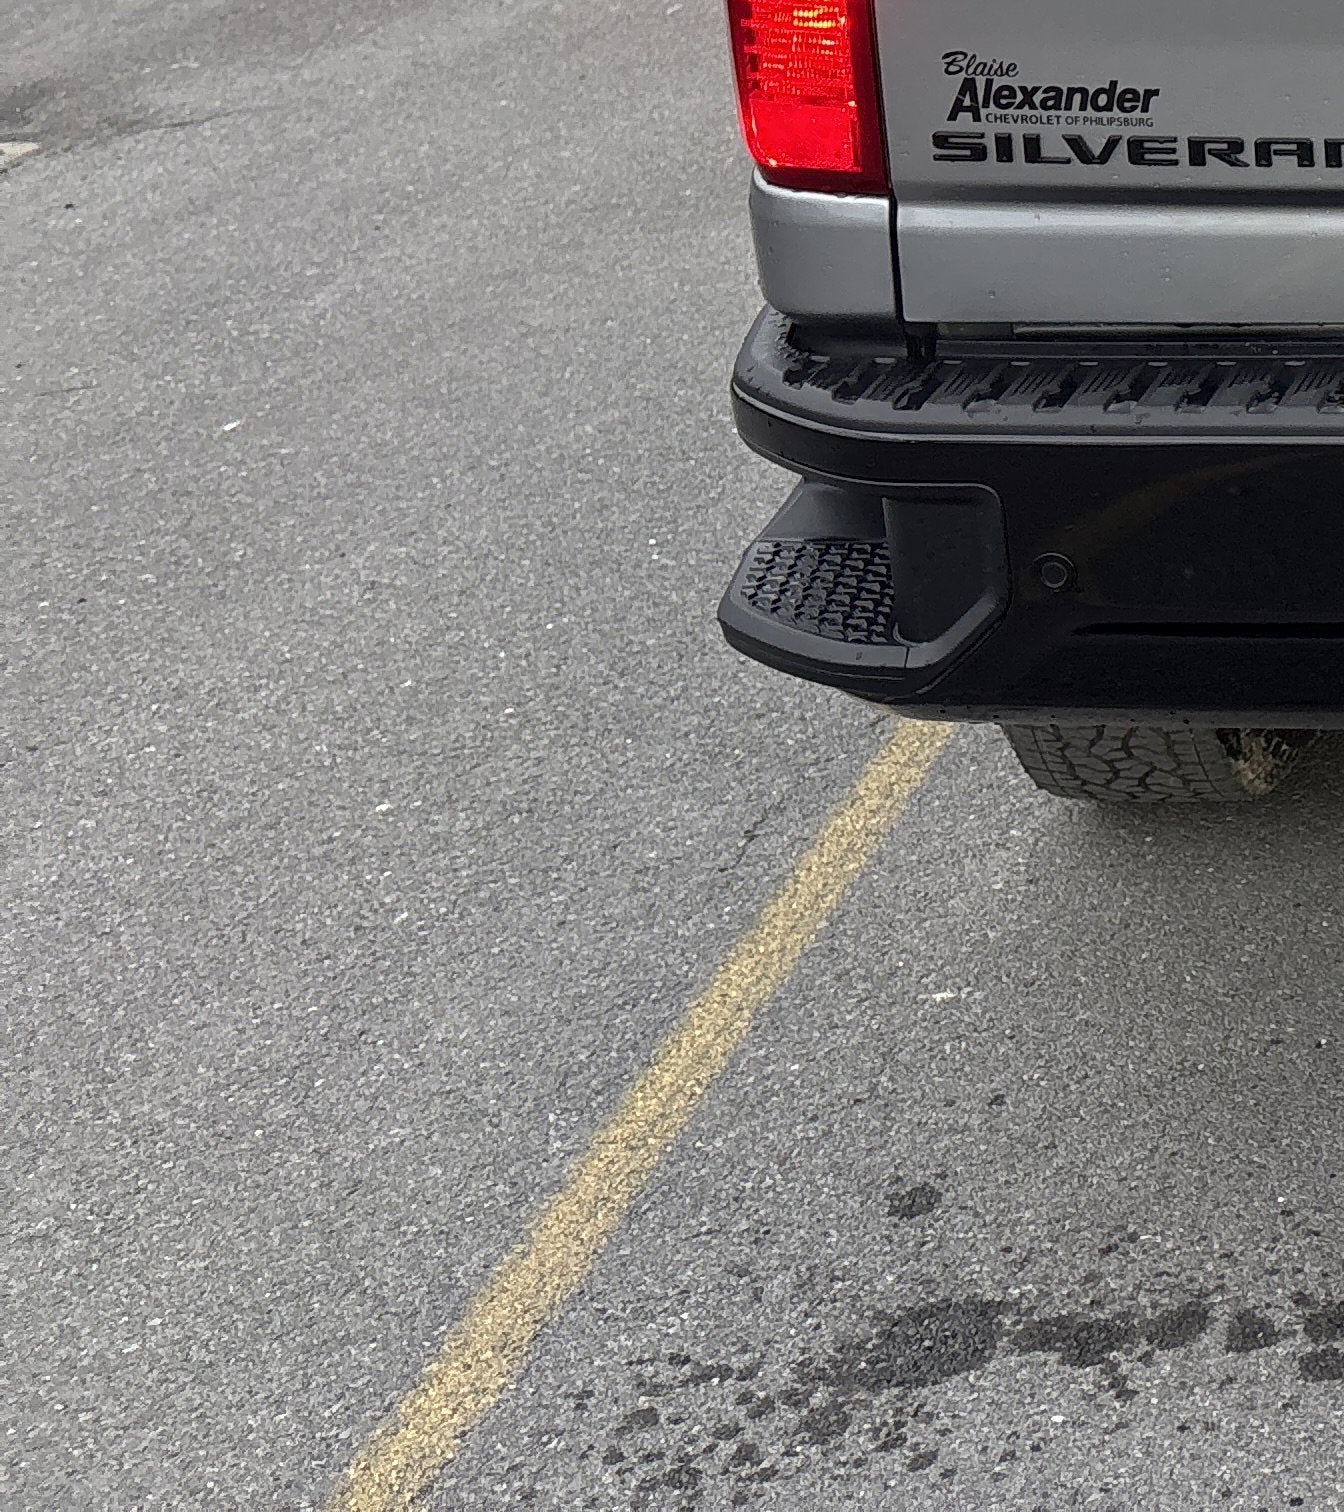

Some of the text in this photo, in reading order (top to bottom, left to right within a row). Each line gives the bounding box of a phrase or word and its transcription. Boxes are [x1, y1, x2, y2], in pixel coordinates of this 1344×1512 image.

[941, 50, 1020, 78] Blaise
[946, 76, 1161, 123] Alexander
[984, 112, 1155, 128] CHEVROLET OF PHILIPSBURG
